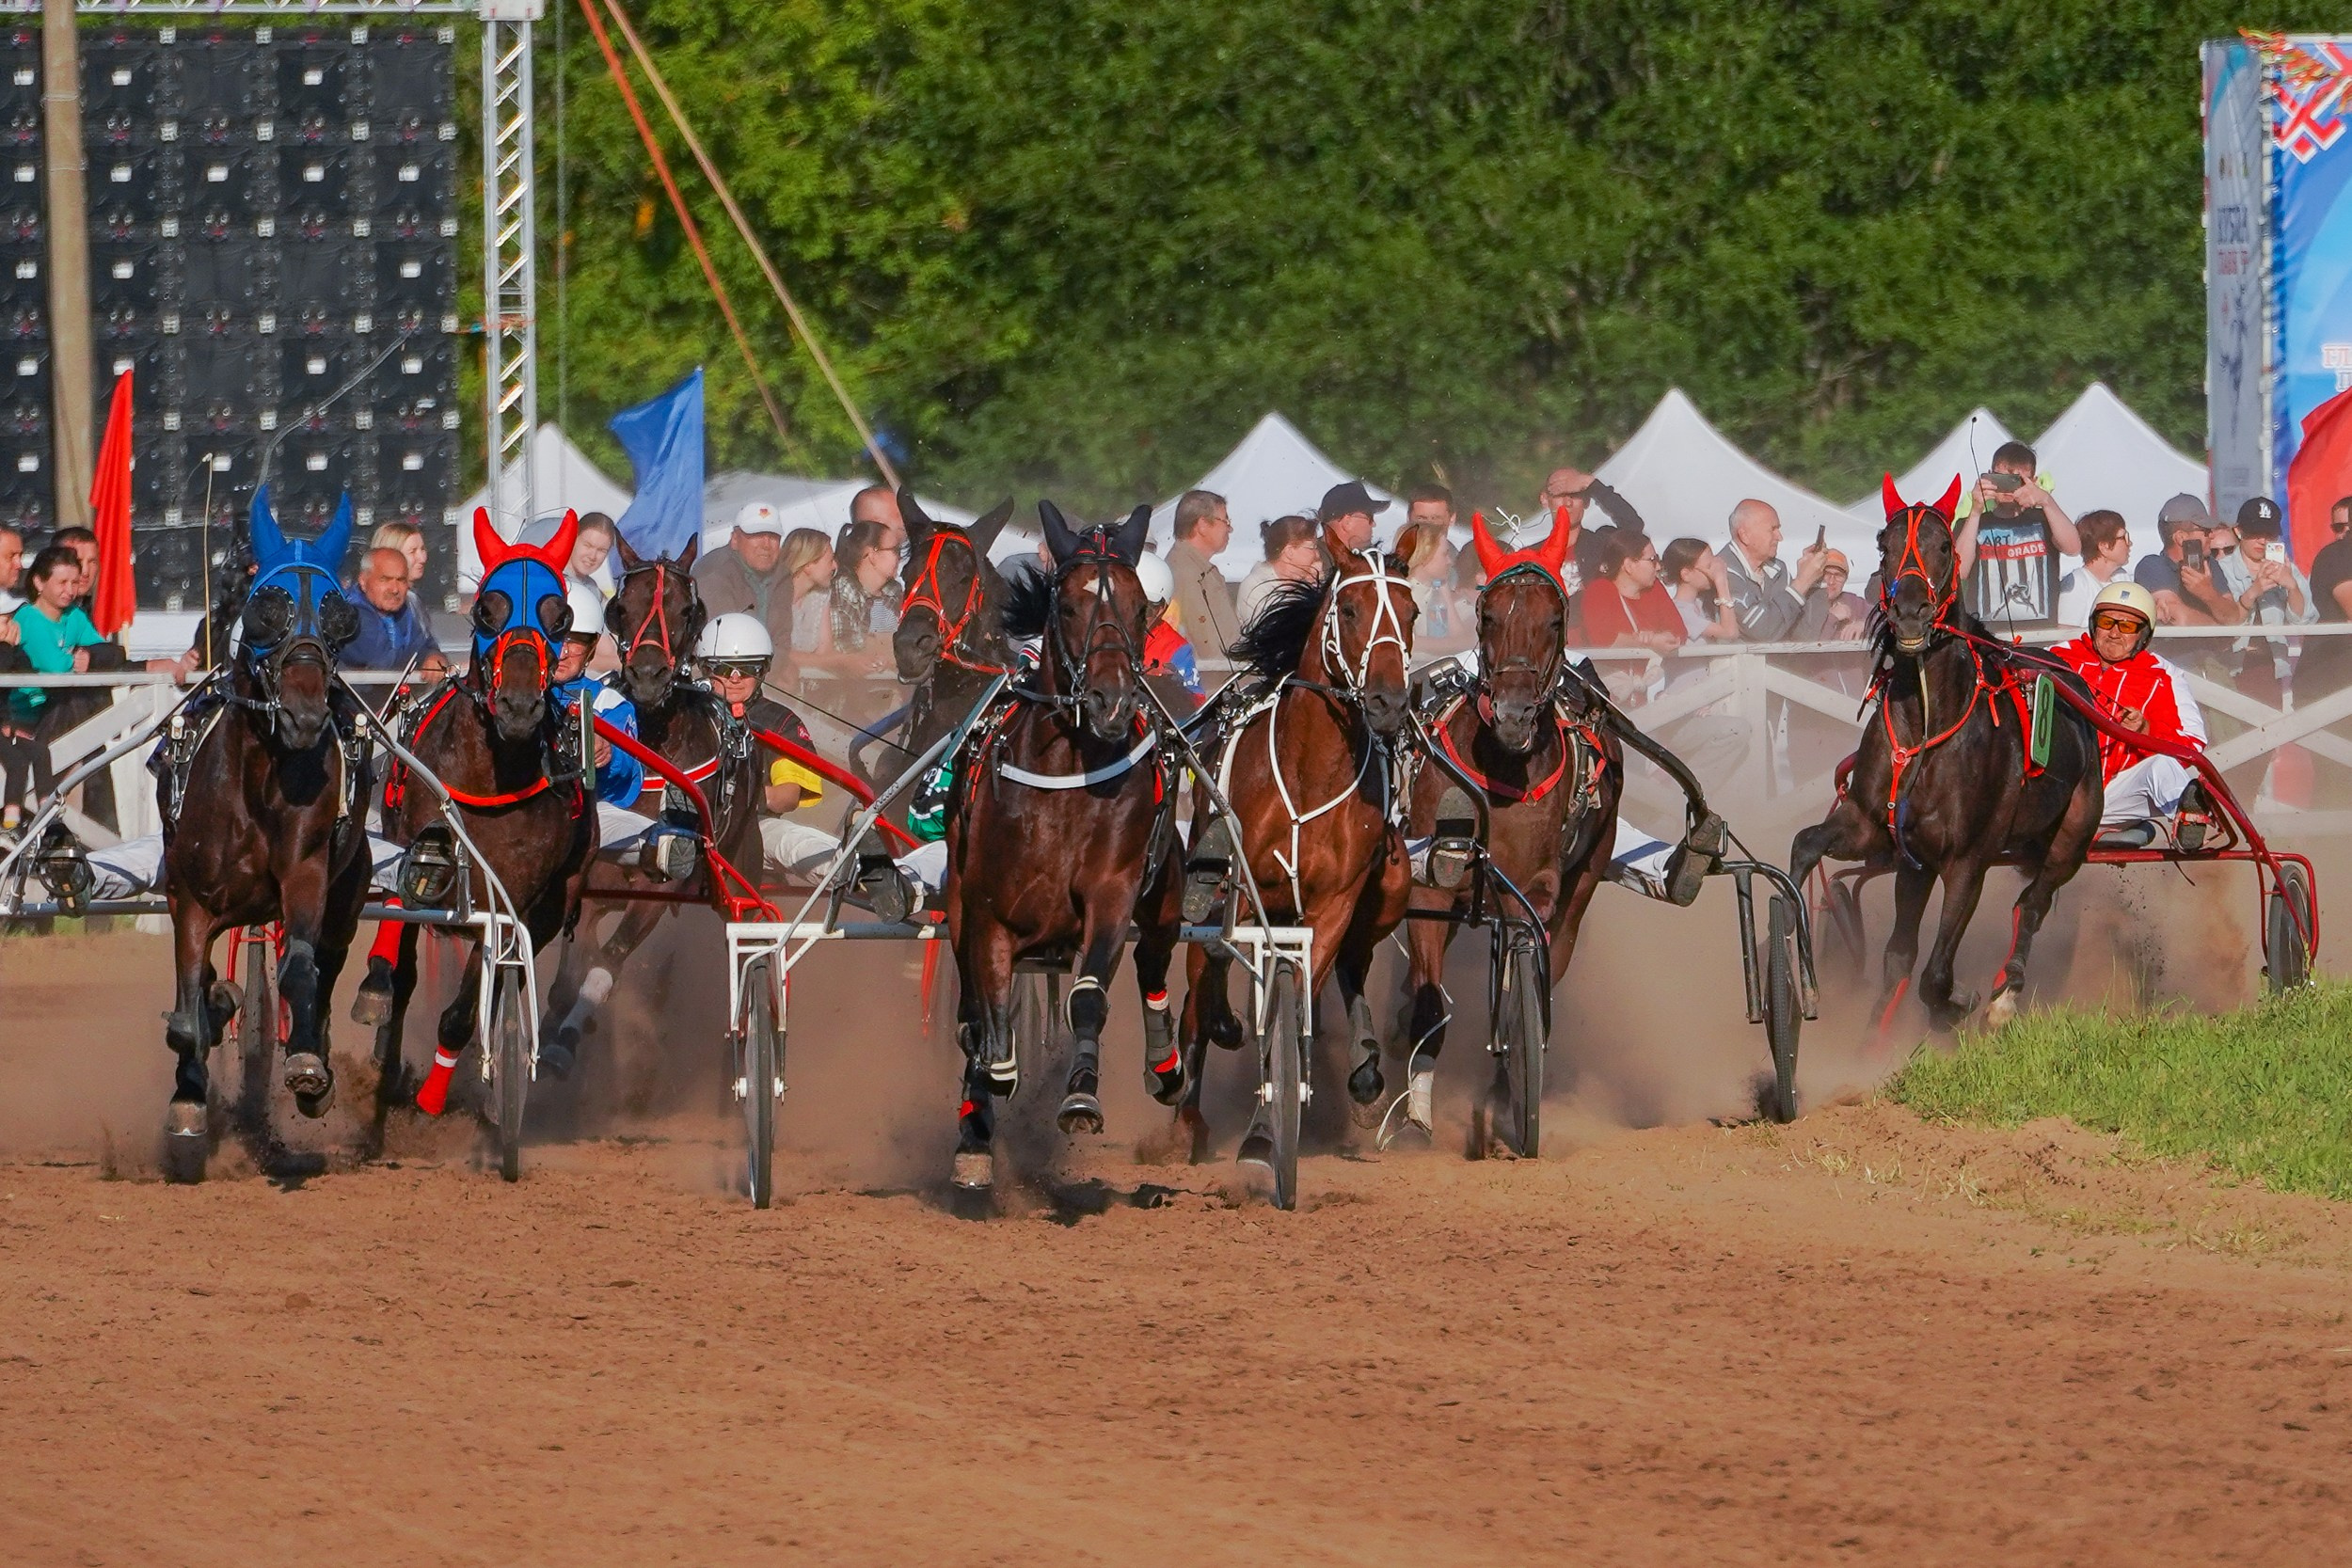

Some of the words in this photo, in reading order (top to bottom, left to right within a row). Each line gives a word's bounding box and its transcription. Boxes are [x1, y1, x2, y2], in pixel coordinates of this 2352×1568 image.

[2259, 502, 2271, 519] LA
[1982, 534, 2010, 546] ART
[2007, 543, 2044, 558] GRADE
[2038, 683, 2050, 749] 8
